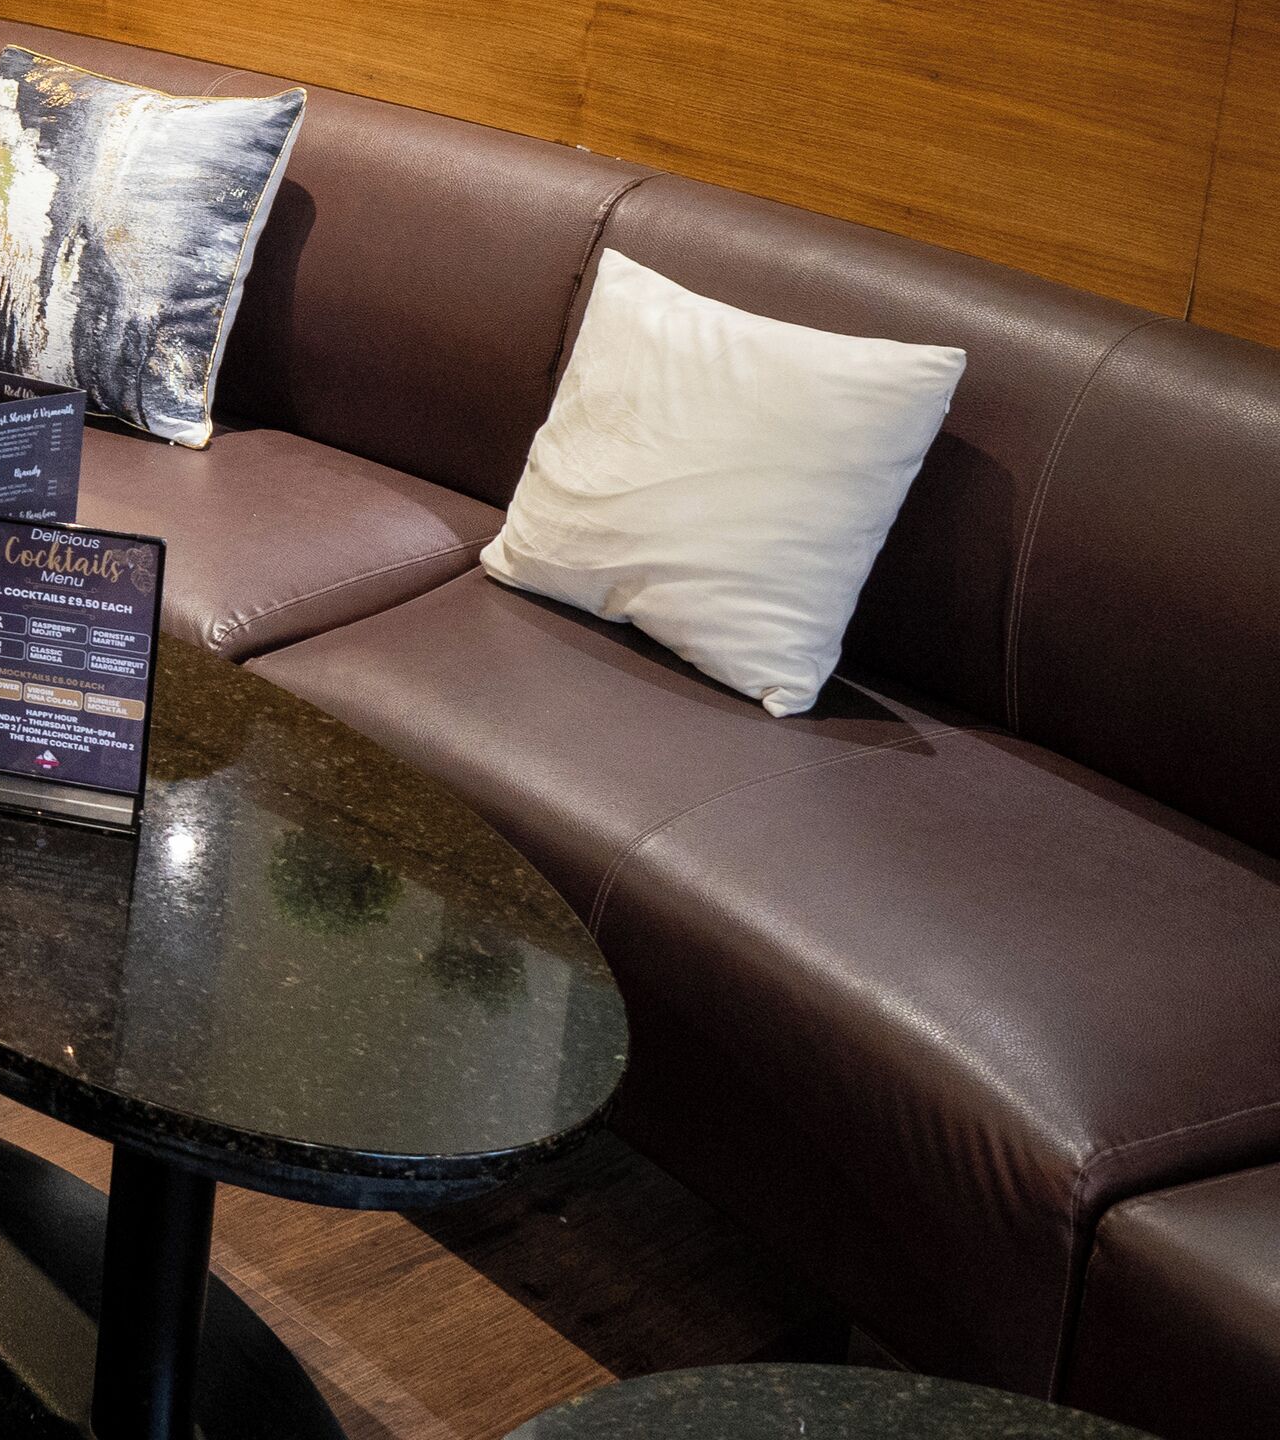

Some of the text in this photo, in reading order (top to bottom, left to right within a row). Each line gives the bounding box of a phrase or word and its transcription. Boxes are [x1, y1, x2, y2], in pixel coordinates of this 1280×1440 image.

[31, 528, 101, 549] Delicious
[5, 536, 124, 583] Cocktails
[41, 570, 85, 588] Menu
[4, 586, 66, 605] COCKTAILS
[68, 596, 100, 609] £9.50
[101, 601, 133, 614] EACH
[31, 627, 62, 638] MOJITO
[32, 621, 76, 634] RASPBERRY
[92, 637, 126, 647] MARTINI
[93, 630, 135, 643] PORNSTAR
[29, 652, 62, 663] MIMOSA
[30, 646, 63, 656] CLASSIC
[90, 662, 135, 674] MARGARITA
[91, 655, 145, 669] PASSIONFRUIT
[0, 667, 50, 682] MOCKTAILS
[80, 681, 105, 691] EACH
[27, 686, 54, 697] VIRGIN
[47, 696, 79, 707] COLADA
[87, 696, 120, 706] SUNRISE
[87, 703, 128, 715] MOCKTAIL
[26, 709, 79, 723] HAPPY HOUR
[28, 718, 71, 731] THURSDAY
[9, 733, 91, 752] THE SAME COCKTAIL
[22, 726, 40, 736] NON
[111, 740, 127, 750] FOR
